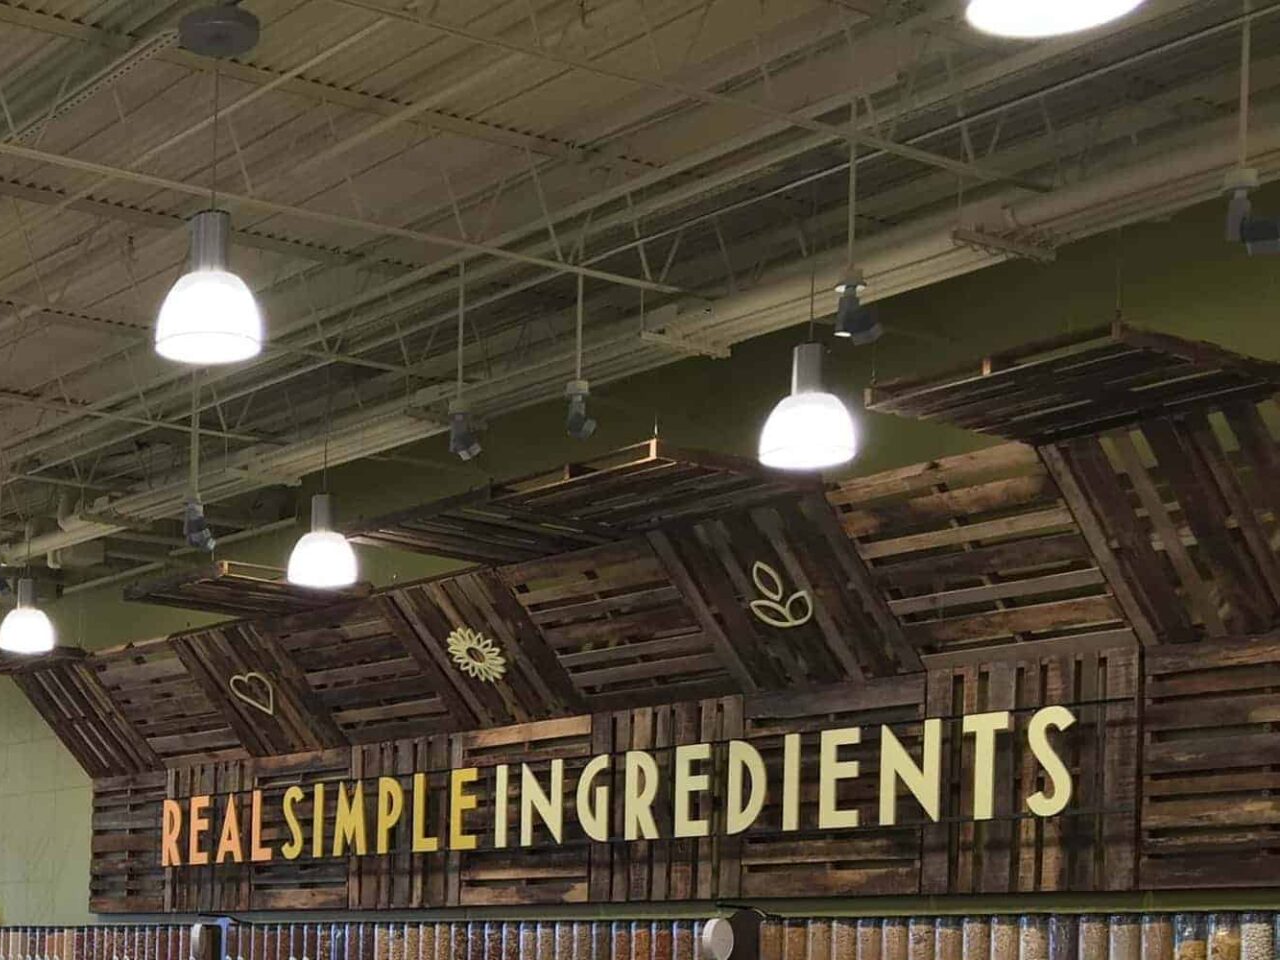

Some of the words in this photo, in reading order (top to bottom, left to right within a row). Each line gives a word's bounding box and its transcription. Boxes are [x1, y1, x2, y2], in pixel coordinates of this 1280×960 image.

[161, 792, 271, 867] REAL
[281, 768, 478, 860] SIMPLE
[494, 704, 1077, 848] INGREDIENTS
